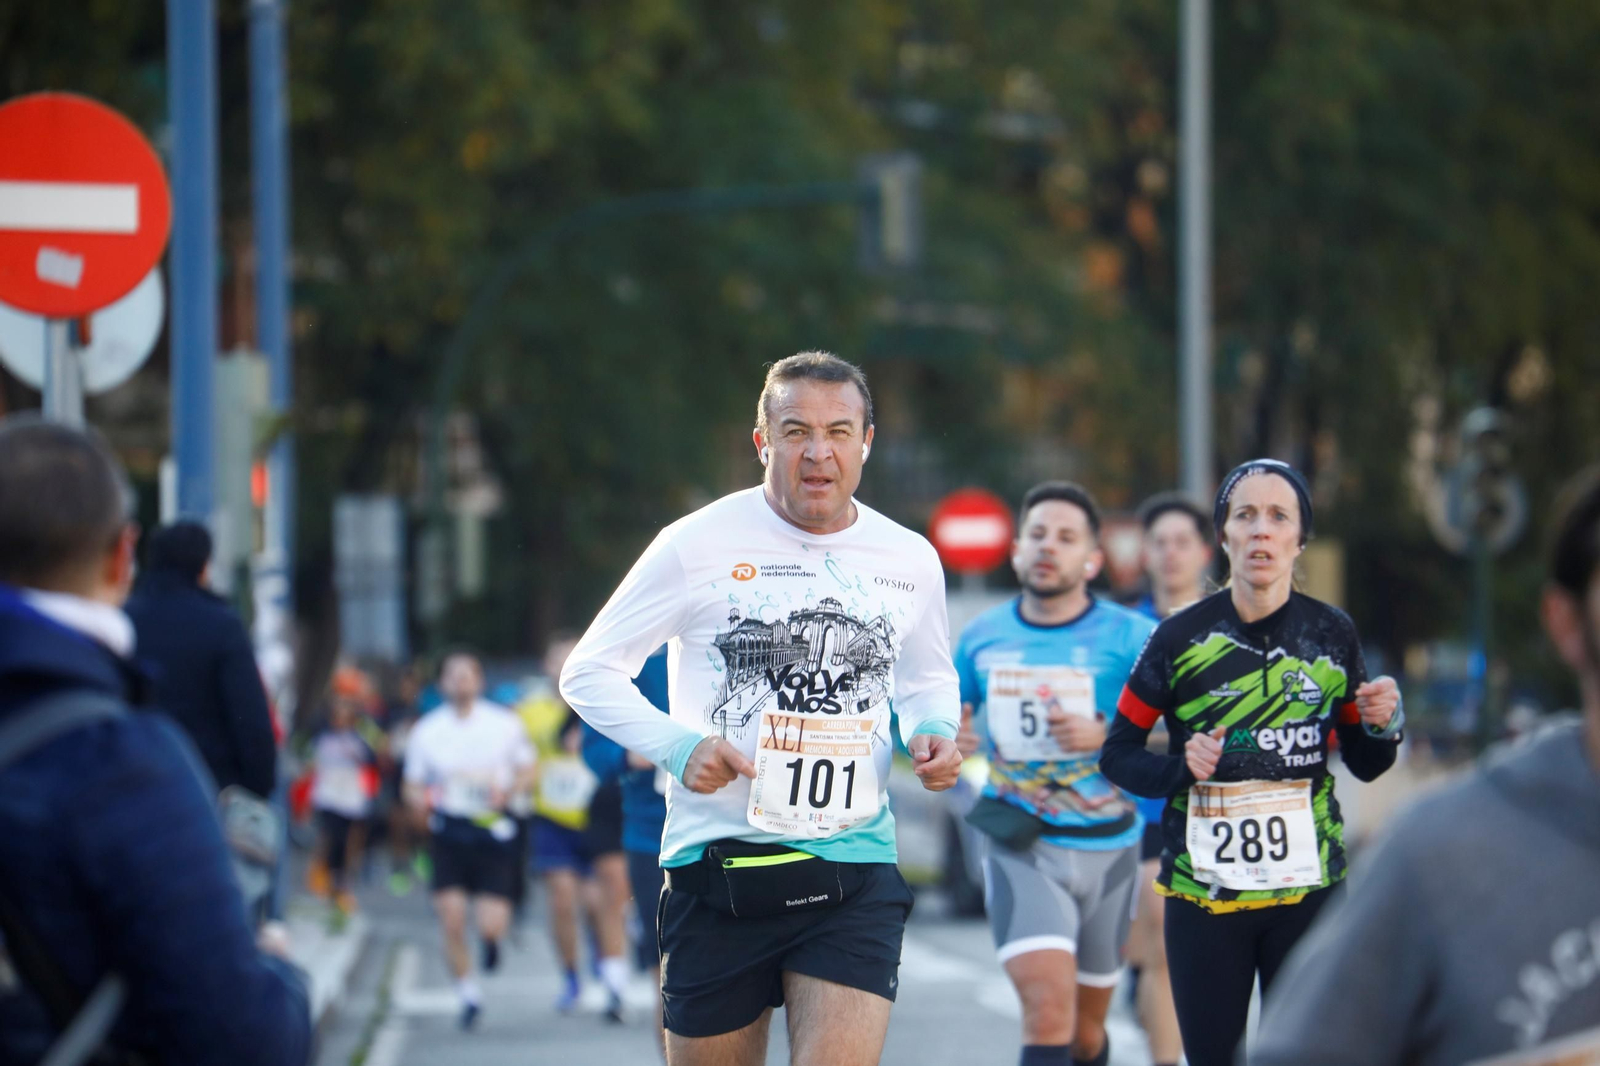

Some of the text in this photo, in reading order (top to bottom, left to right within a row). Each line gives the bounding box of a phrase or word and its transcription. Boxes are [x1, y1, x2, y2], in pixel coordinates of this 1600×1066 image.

[760, 563, 802, 571] nationale
[761, 570, 817, 578] nederlanden
[874, 576, 915, 593] OYSHO
[777, 689, 842, 715] MOS
[764, 714, 806, 753] XLI
[1282, 751, 1322, 768] TRAIL
[786, 757, 856, 809] 101
[1212, 816, 1288, 864] 289
[808, 894, 829, 903] Gears
